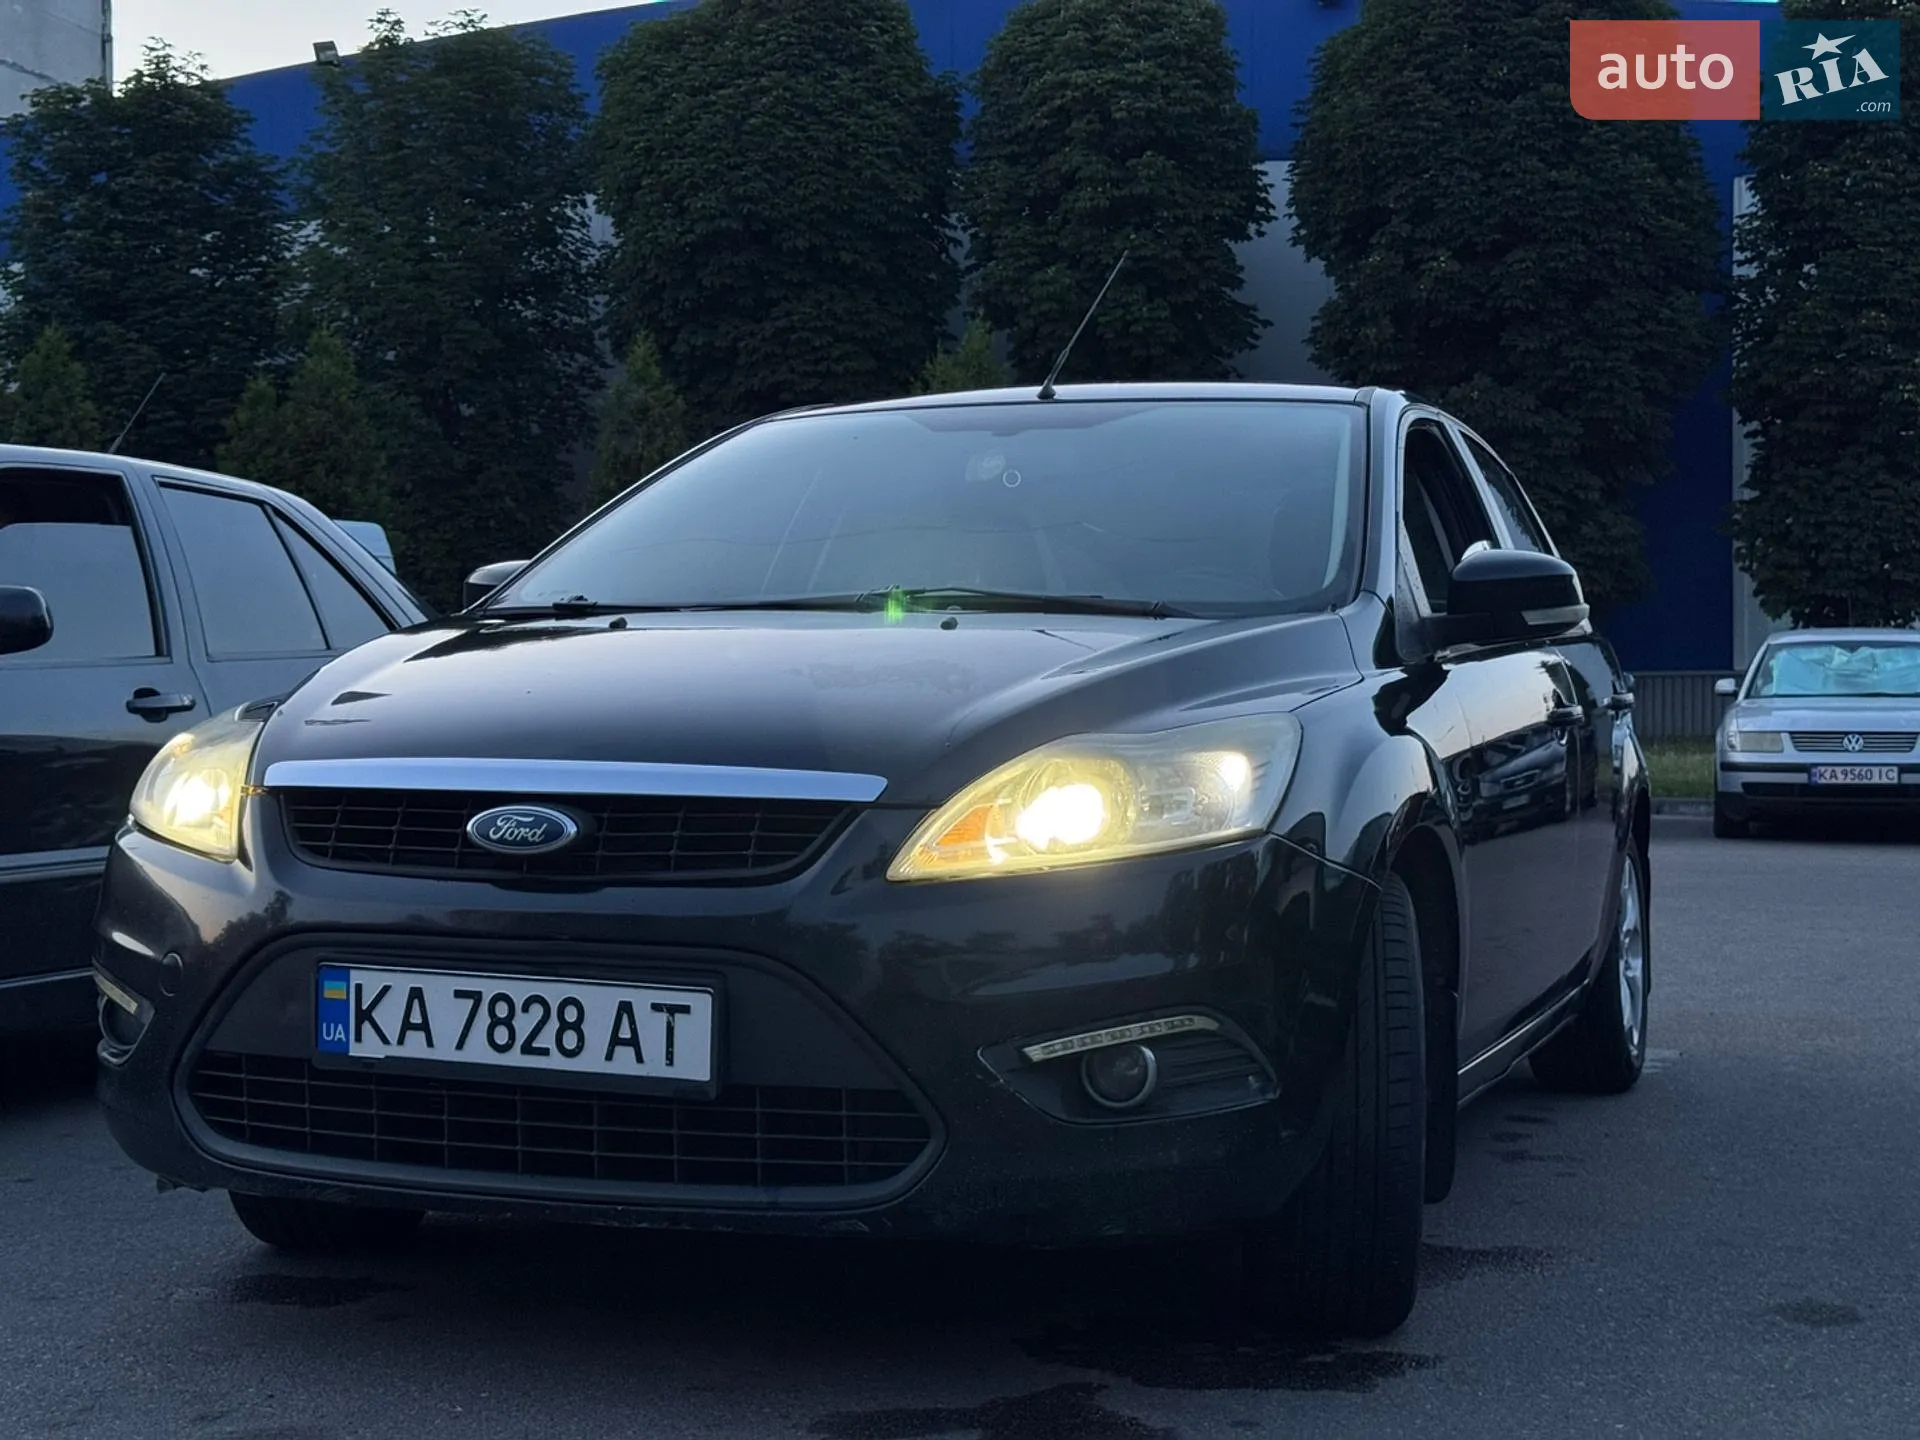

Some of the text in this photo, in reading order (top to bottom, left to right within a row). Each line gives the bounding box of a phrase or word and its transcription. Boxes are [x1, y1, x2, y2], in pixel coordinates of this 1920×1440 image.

[1819, 767, 1896, 781] KA 9560 IC
[489, 814, 548, 842] Ford
[322, 1022, 347, 1042] UA
[353, 982, 692, 1068] KA 7828 AT
